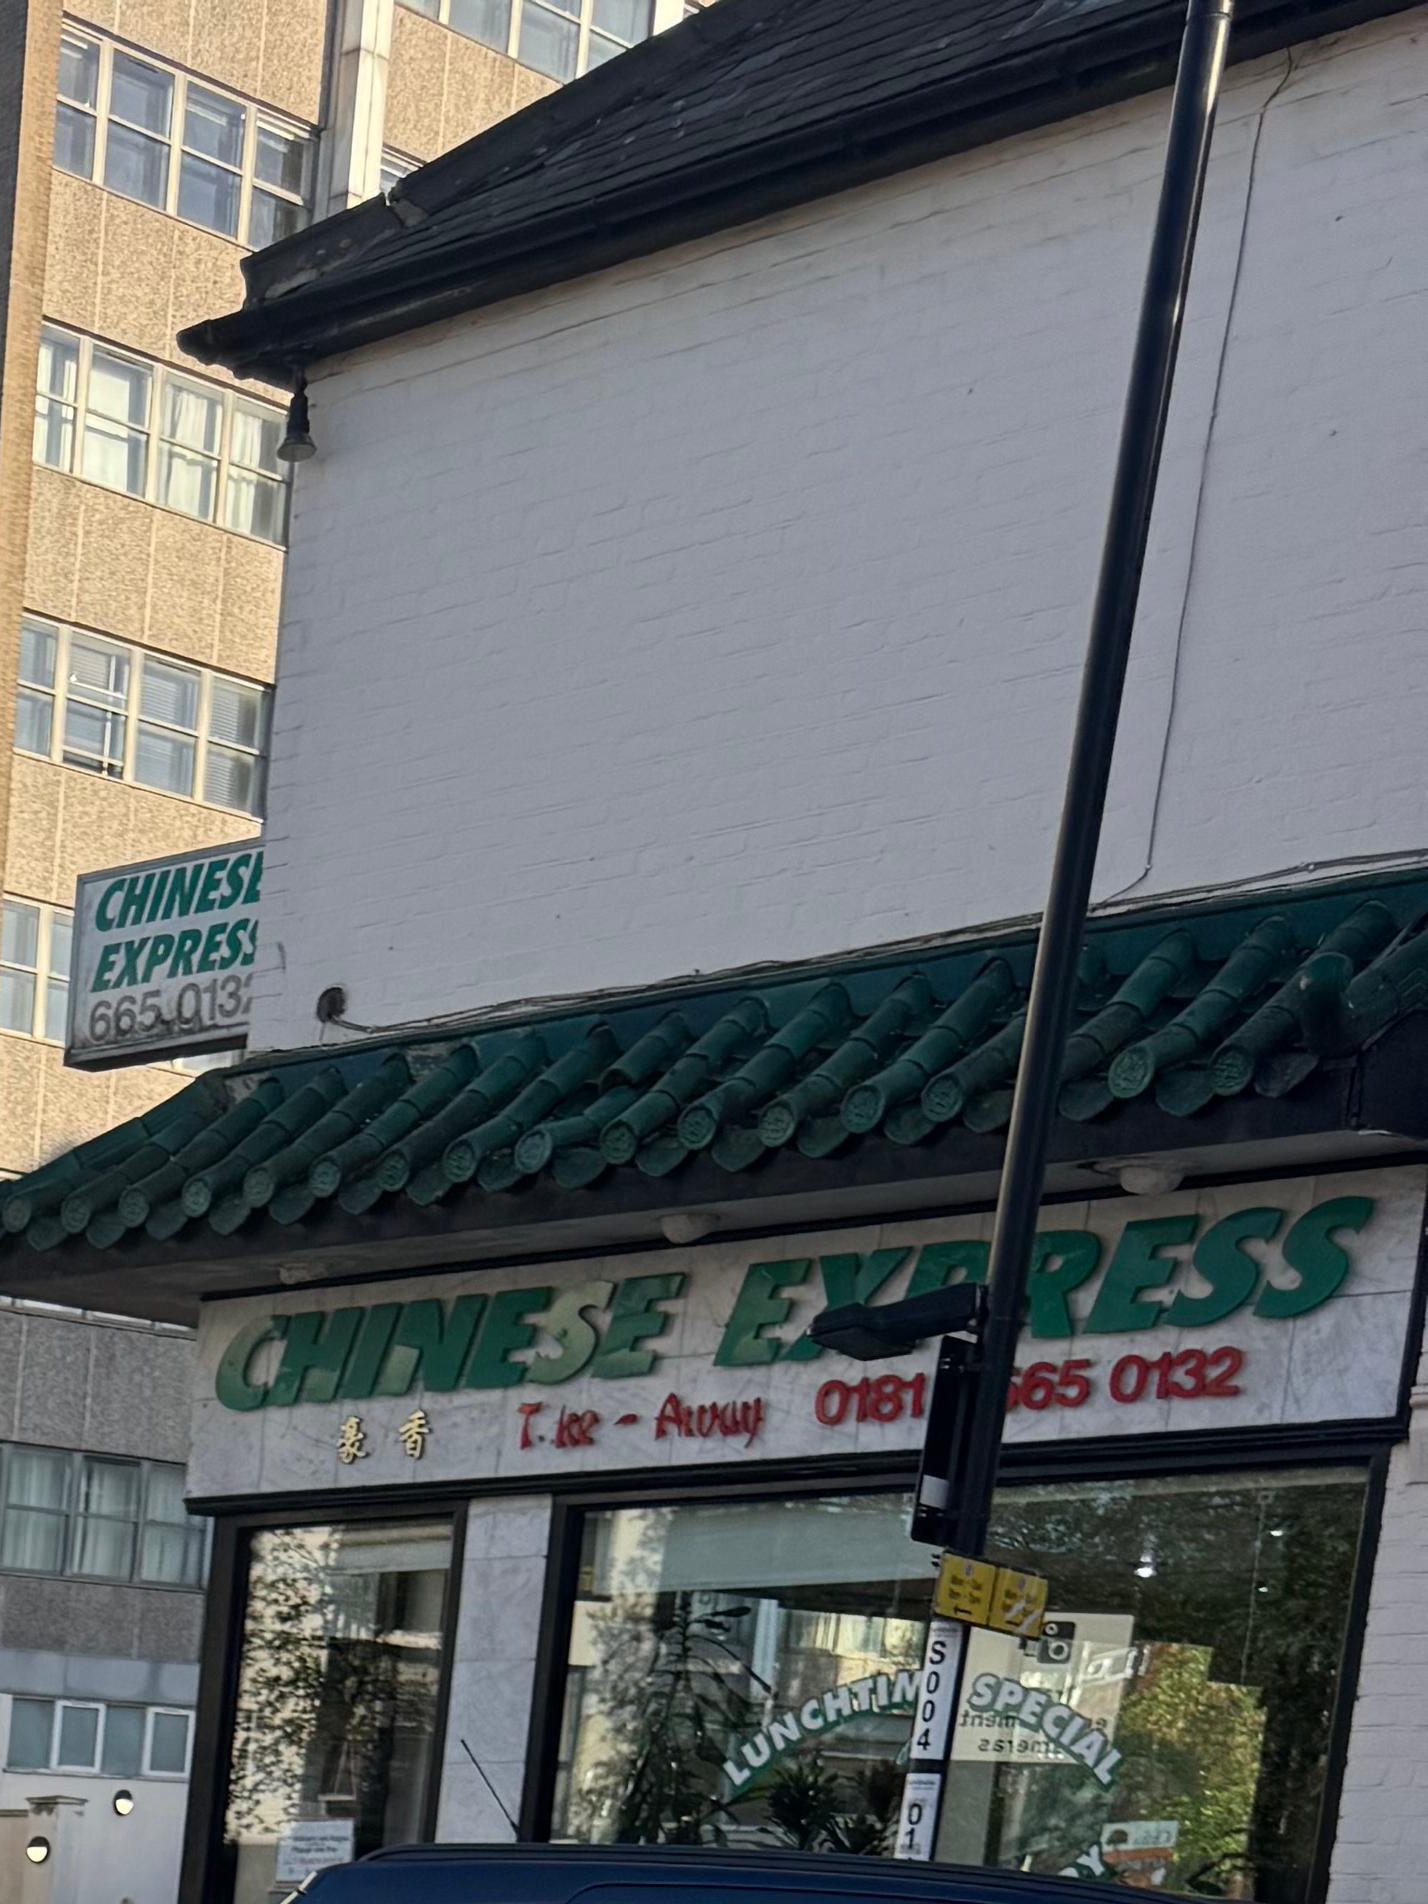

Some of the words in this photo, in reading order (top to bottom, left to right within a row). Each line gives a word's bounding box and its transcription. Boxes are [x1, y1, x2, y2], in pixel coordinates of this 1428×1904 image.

[215, 1272, 688, 1412] CHINESE
[815, 1372, 926, 1426] 0181
[1109, 1346, 1243, 1403] 0132
[723, 1669, 923, 1787] LUNCHTIM
[969, 1674, 1122, 1786] SPECIAL
